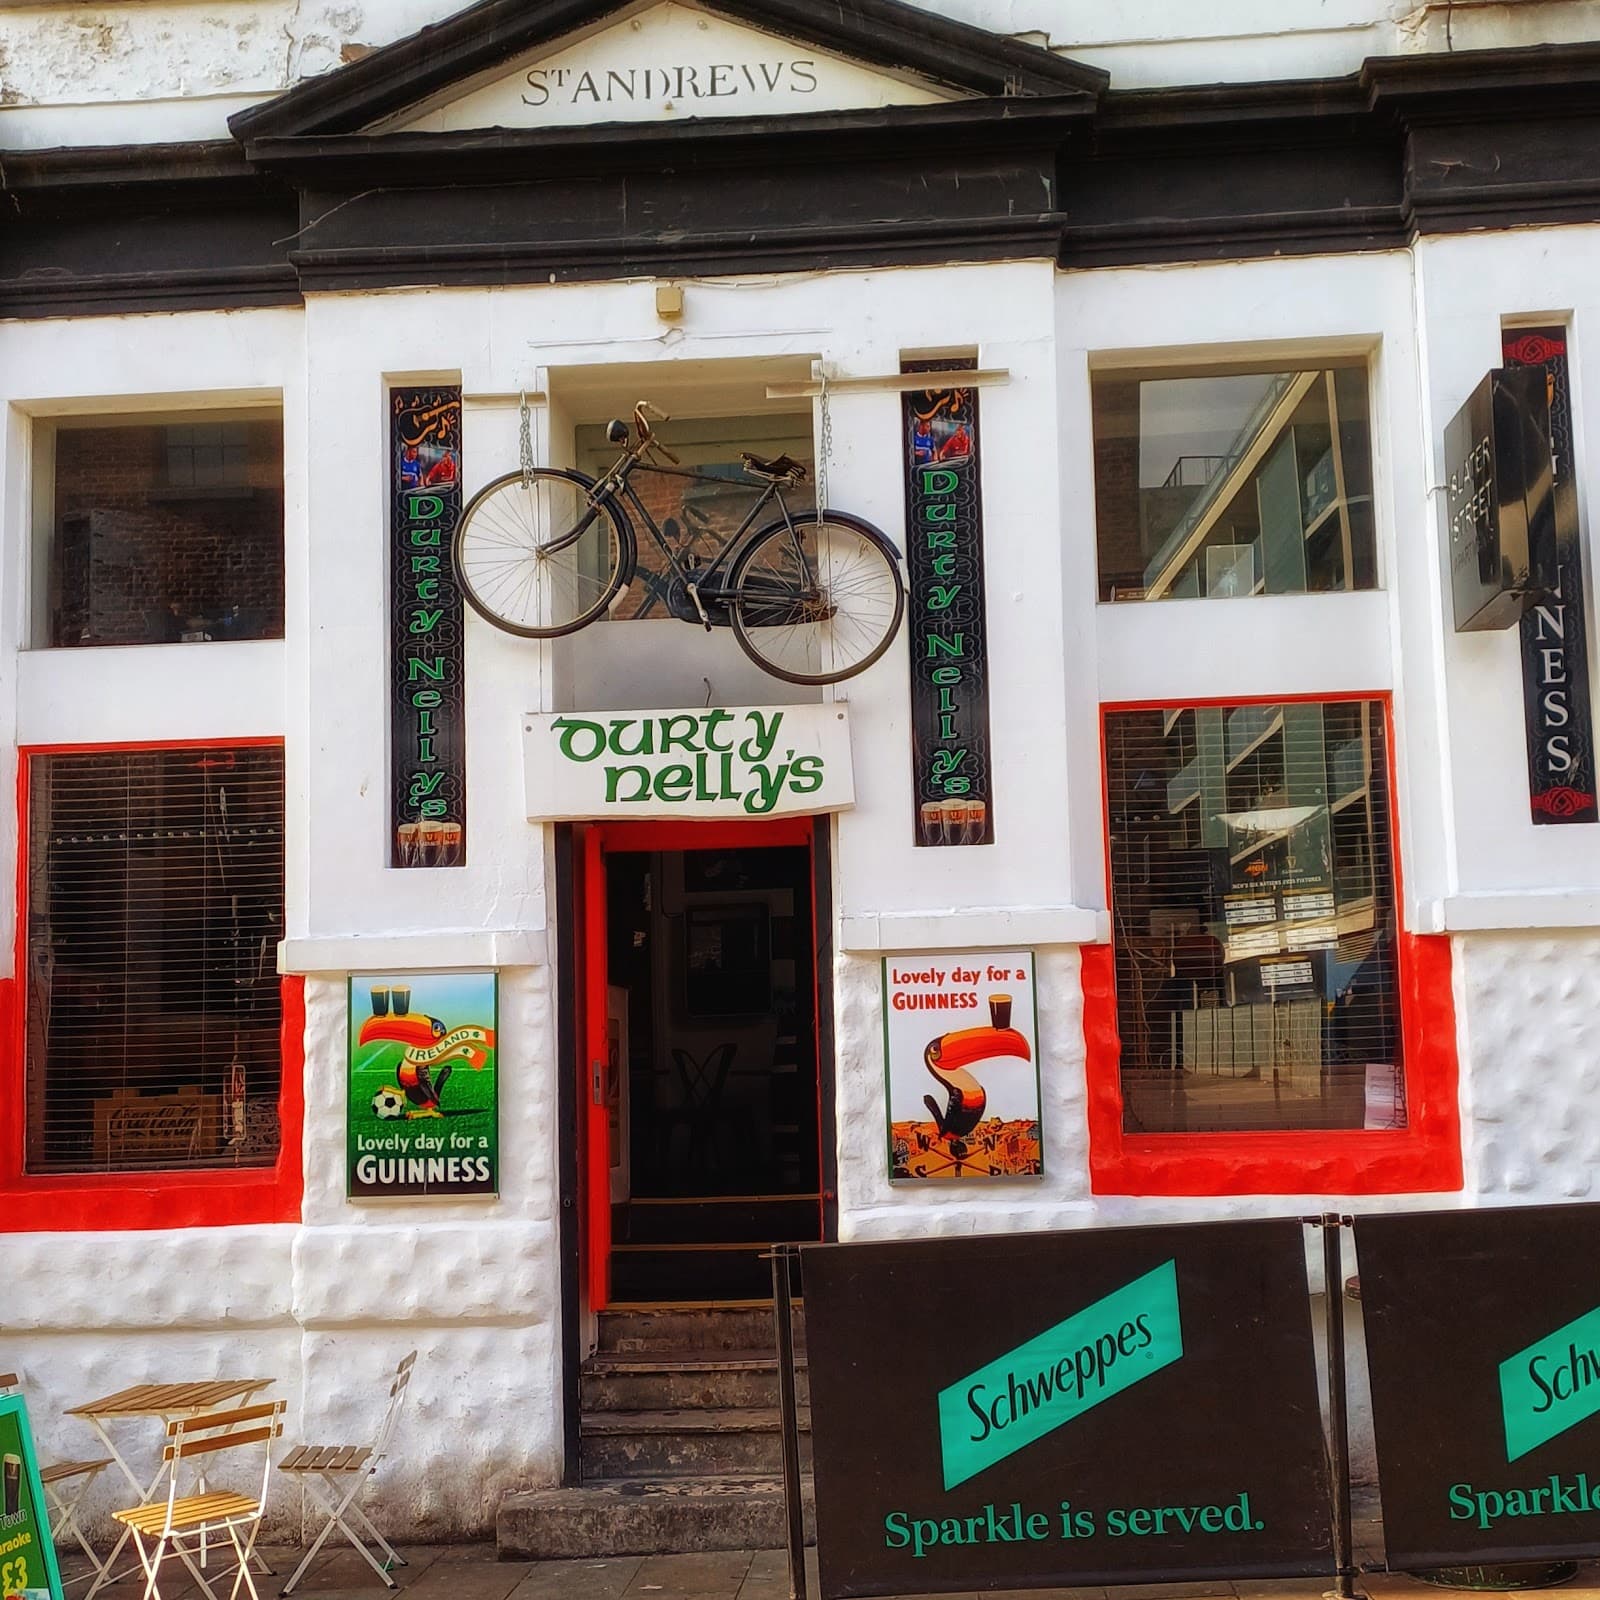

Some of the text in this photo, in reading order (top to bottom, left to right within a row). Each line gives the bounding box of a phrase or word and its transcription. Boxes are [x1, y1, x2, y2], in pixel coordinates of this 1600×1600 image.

[571, 60, 817, 103] ANDREWS
[1451, 435, 1490, 501] SLATER
[1453, 478, 1492, 542] STREET
[892, 965, 1026, 986] Lovely day for a
[892, 992, 978, 1011] GUINNESS
[409, 1030, 469, 1060] IRELAND
[357, 1131, 488, 1153] Lovely day for a
[356, 1153, 490, 1184] GUINNESS
[967, 1313, 1153, 1442] Schweppes
[884, 1492, 1265, 1558] Sparkle is served.
[2, 1556, 28, 1600] £3
